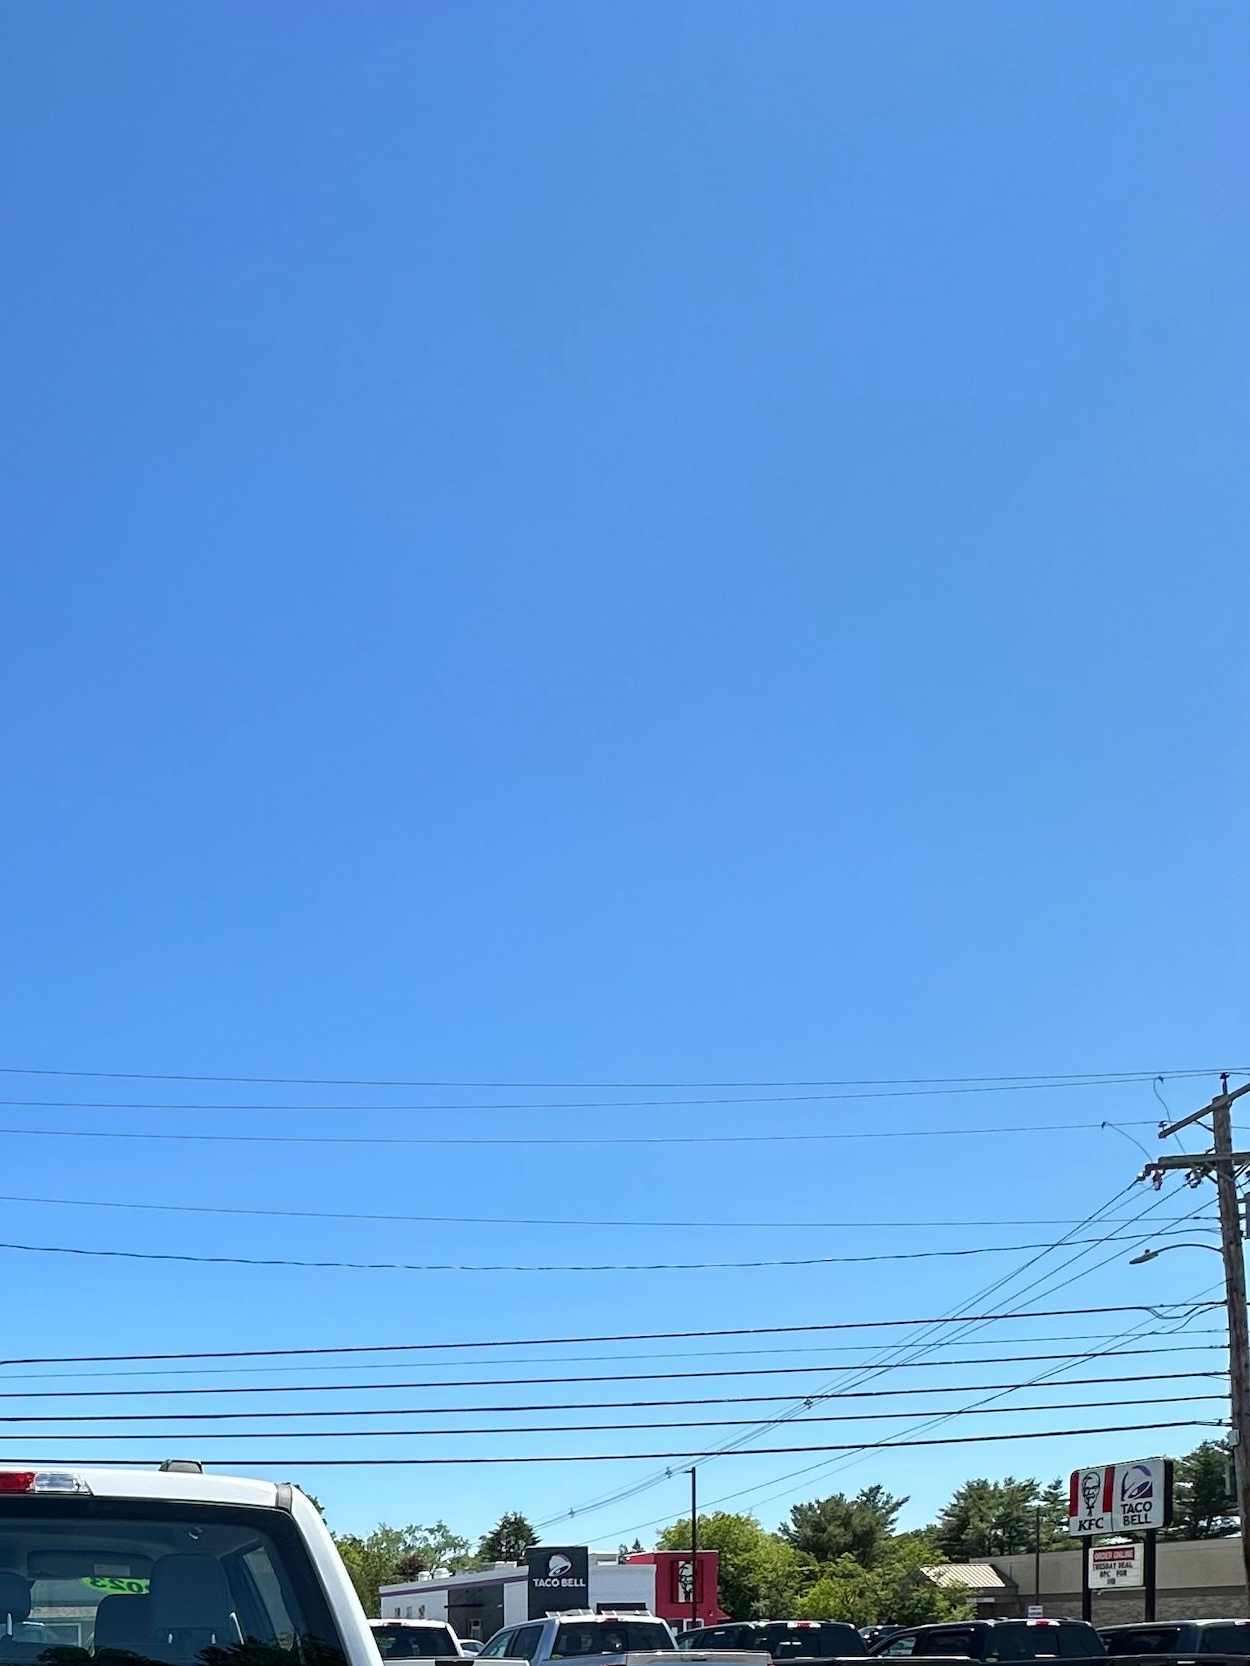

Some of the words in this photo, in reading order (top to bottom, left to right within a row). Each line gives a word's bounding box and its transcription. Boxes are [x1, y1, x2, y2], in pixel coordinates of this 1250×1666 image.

[1121, 1501, 1152, 1515] TACO
[1077, 1517, 1104, 1531] KFC
[1123, 1514, 1152, 1526] BELL
[532, 1578, 560, 1588] TACO
[561, 1578, 586, 1587] BELL
